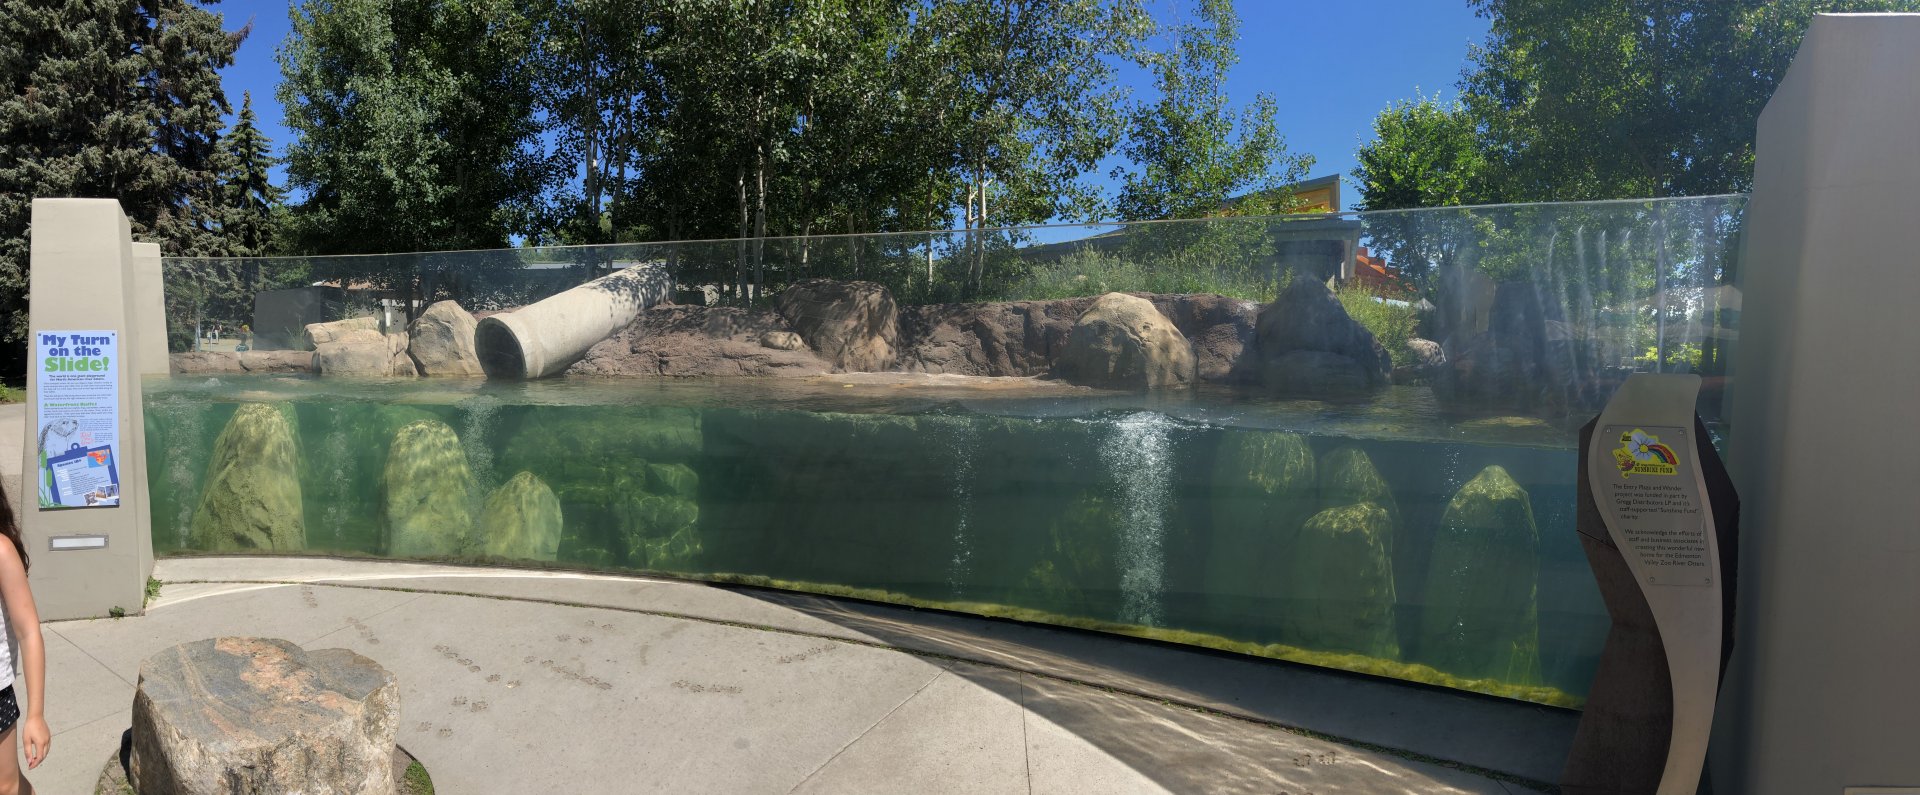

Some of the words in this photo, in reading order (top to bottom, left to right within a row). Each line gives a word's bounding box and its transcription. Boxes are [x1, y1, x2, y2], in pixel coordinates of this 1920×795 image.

[43, 335, 67, 347] My
[71, 335, 110, 345] Turn
[49, 347, 69, 356] on
[74, 346, 101, 356] the
[45, 357, 109, 372] Slide!
